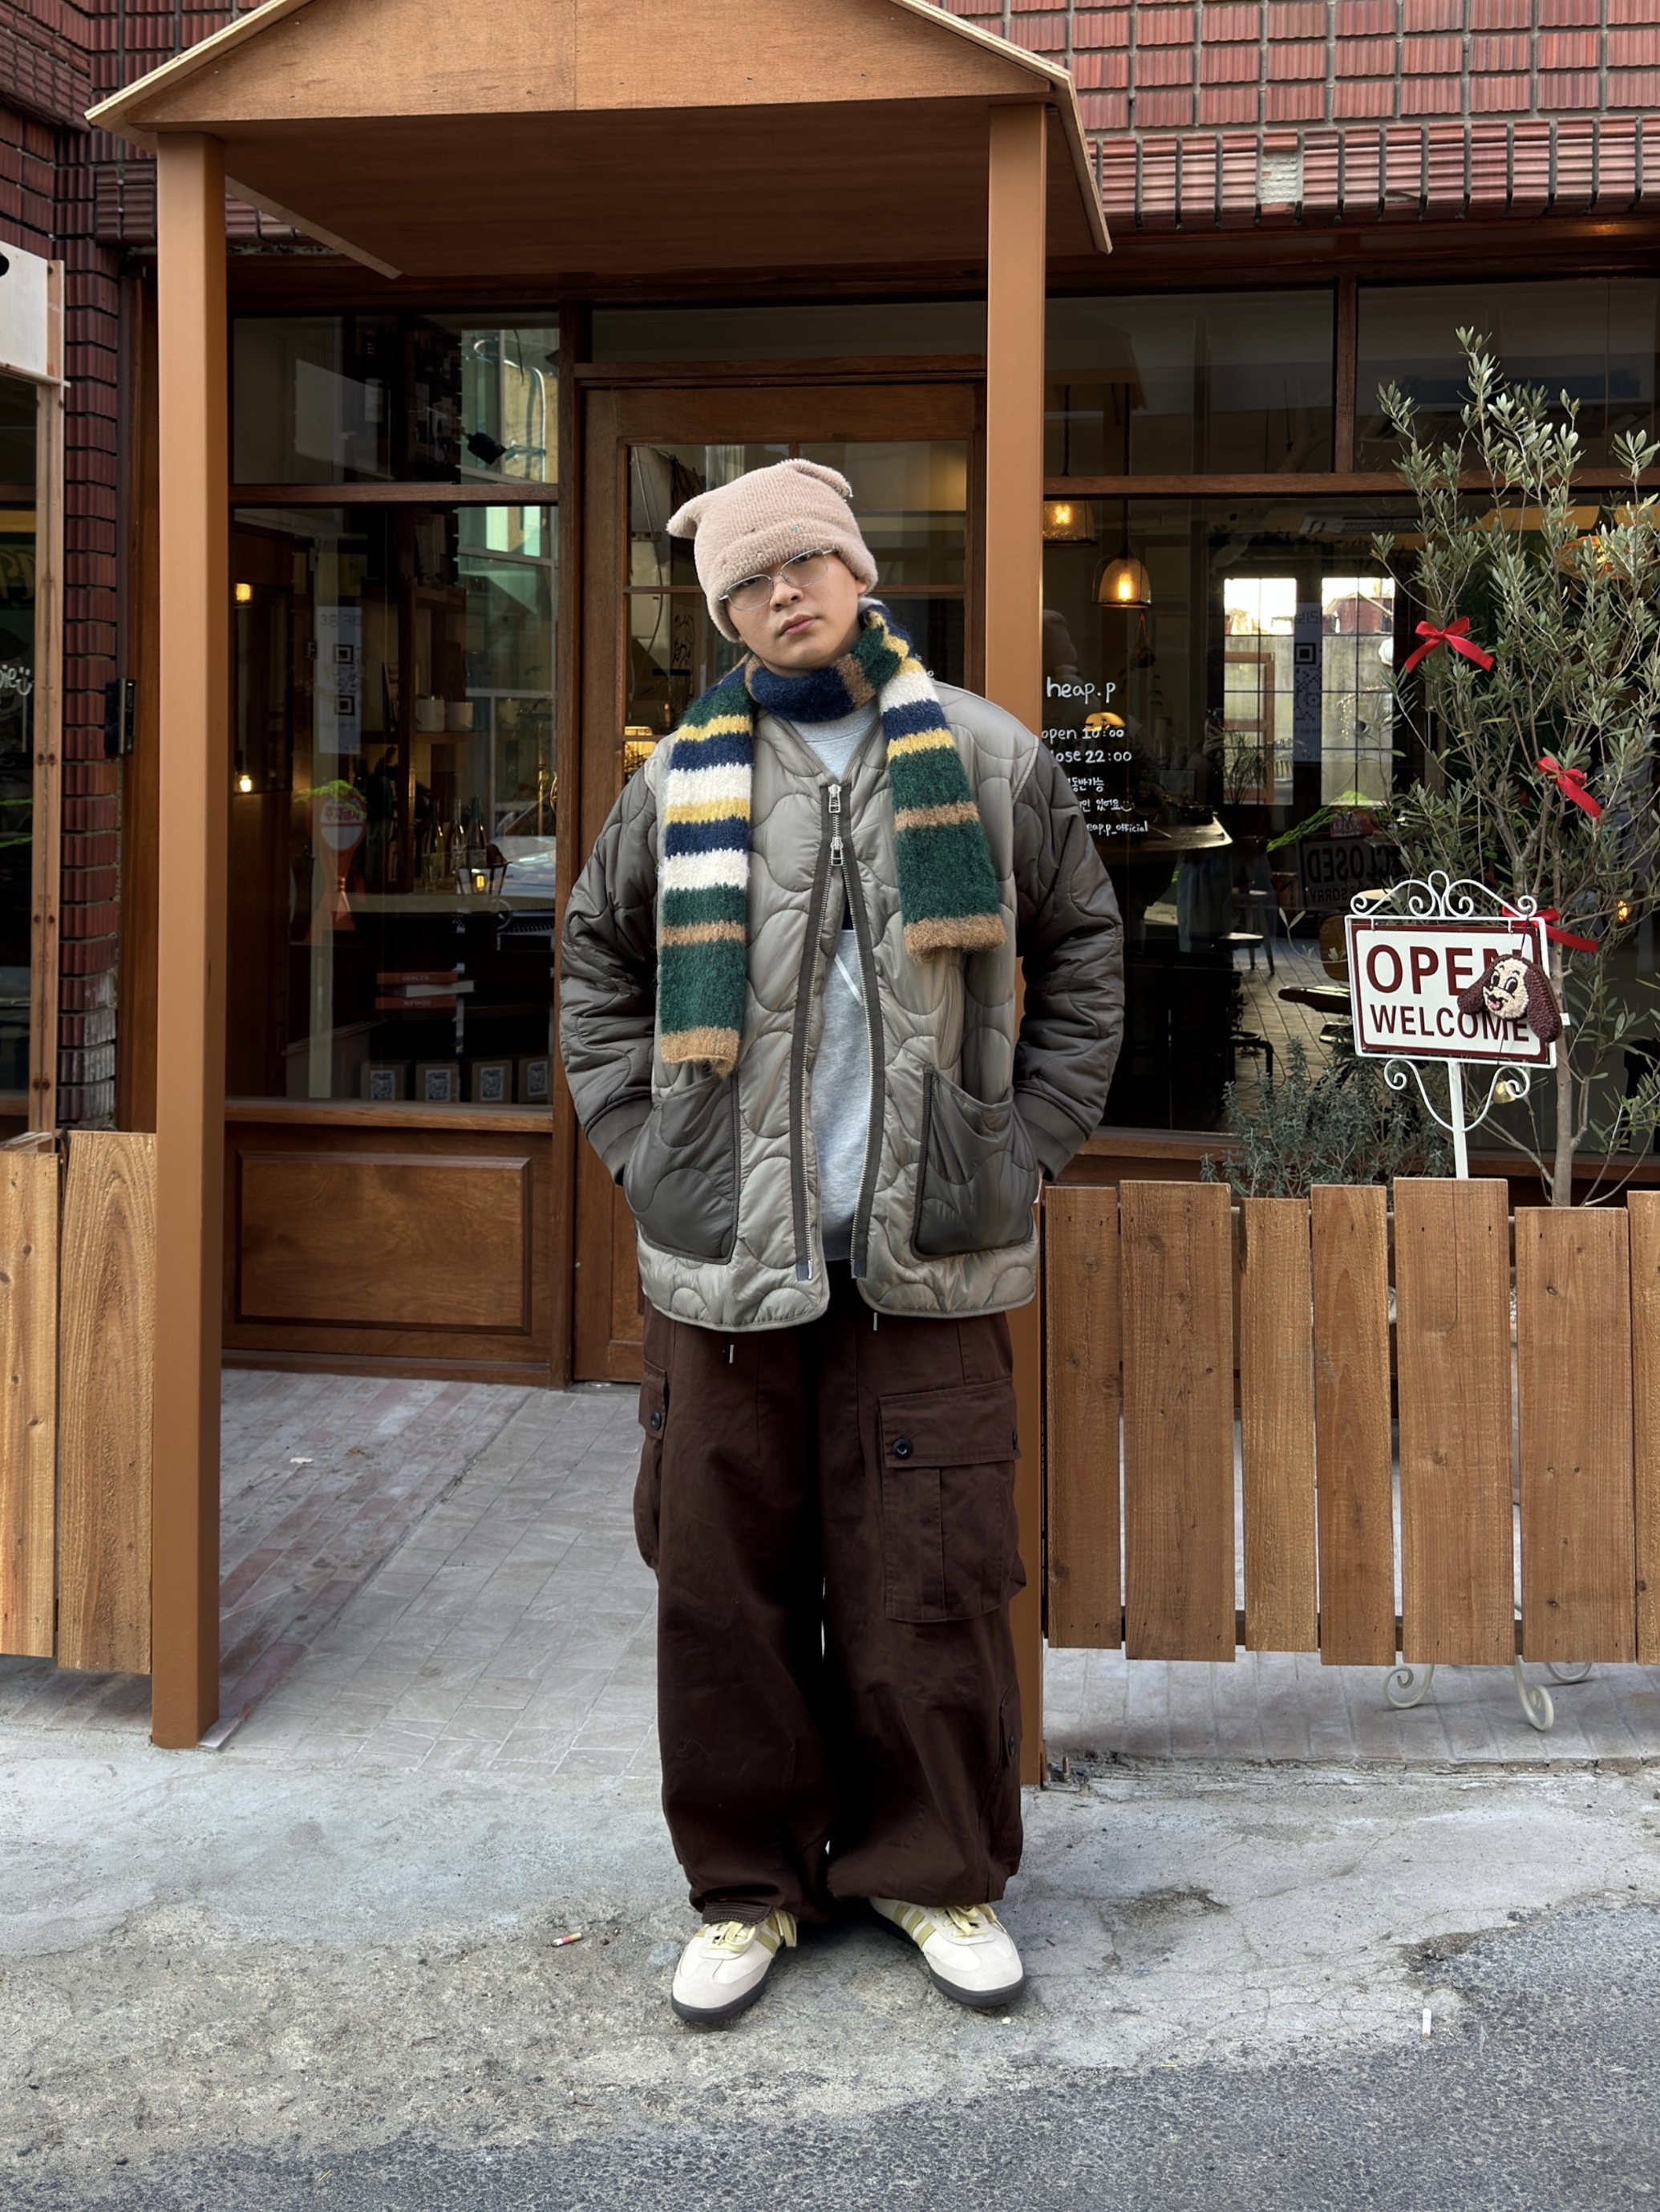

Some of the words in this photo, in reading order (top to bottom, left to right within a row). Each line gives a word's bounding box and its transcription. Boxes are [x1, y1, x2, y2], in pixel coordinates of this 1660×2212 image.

[1041, 728, 1077, 744] open
[1082, 727, 1124, 739] 10:00
[1085, 750, 1132, 764] 22:00
[1067, 776, 1105, 792] 동반가능
[1079, 798, 1091, 812] 인
[1095, 798, 1120, 812] 있어요
[1086, 820, 1148, 837] eap.p_official
[1370, 1003, 1529, 1043] WELCOME
